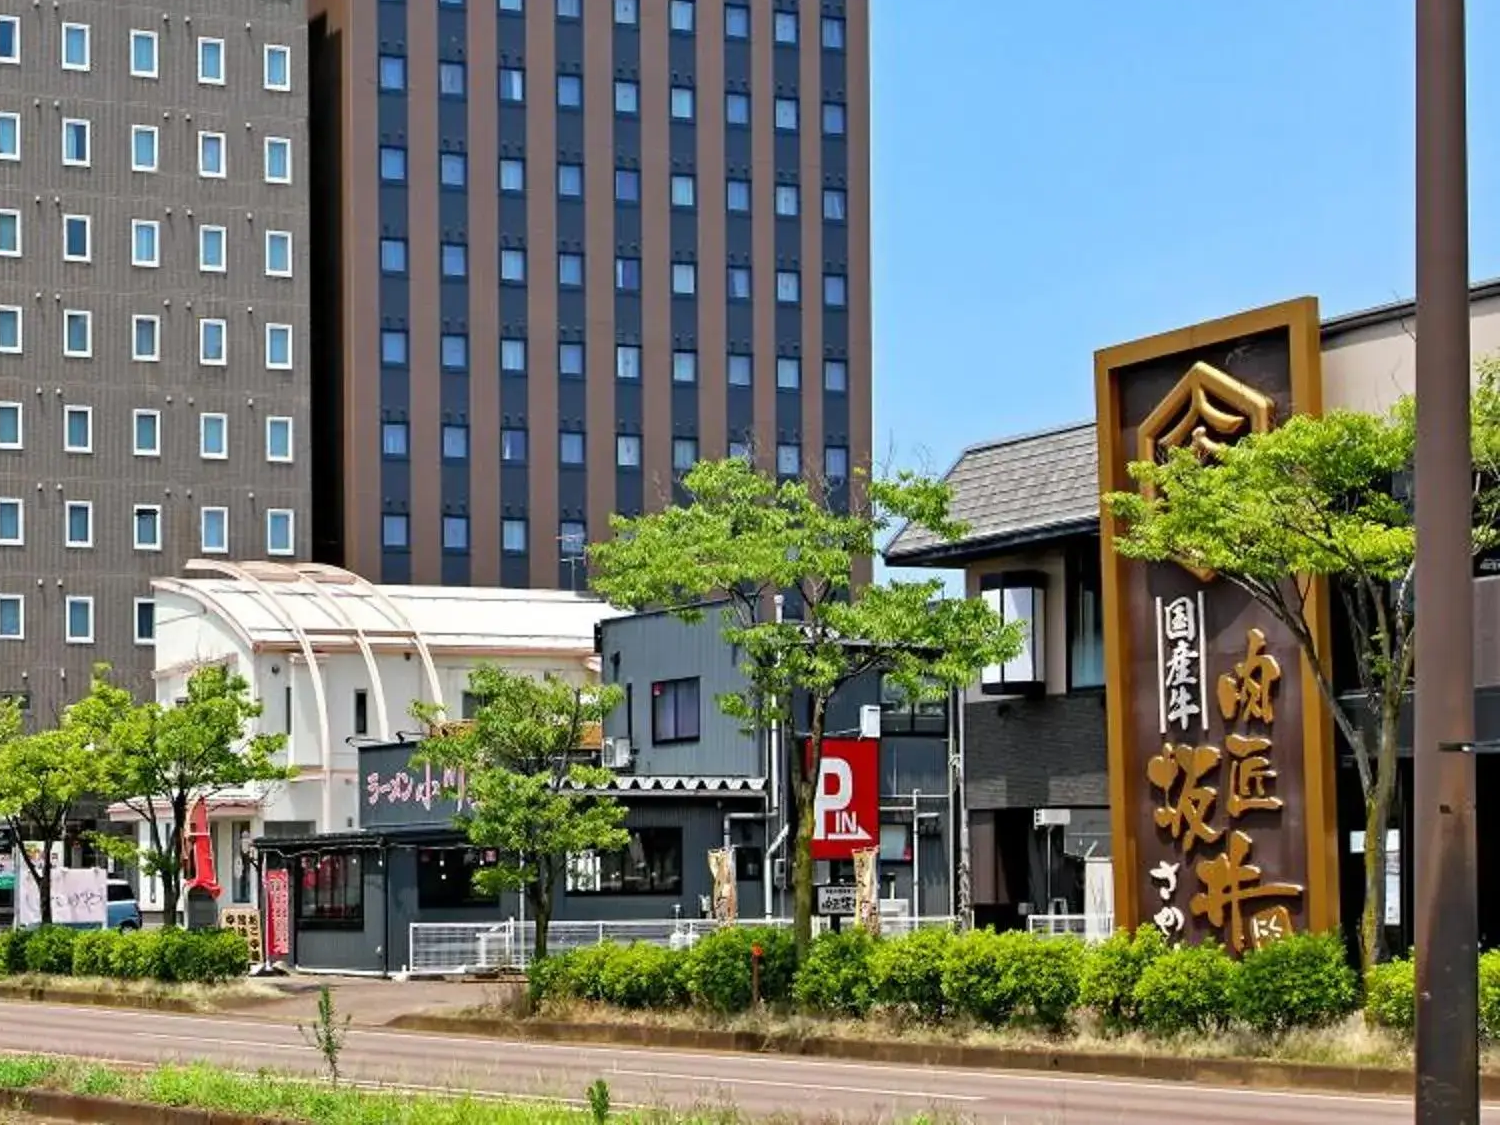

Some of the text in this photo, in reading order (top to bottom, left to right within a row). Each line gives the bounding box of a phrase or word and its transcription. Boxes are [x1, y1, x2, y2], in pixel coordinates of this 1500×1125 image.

[1164, 596, 1199, 730] 国産牛
[1217, 628, 1284, 817] 肉匠
[813, 757, 853, 840] P
[835, 810, 858, 835] IN
